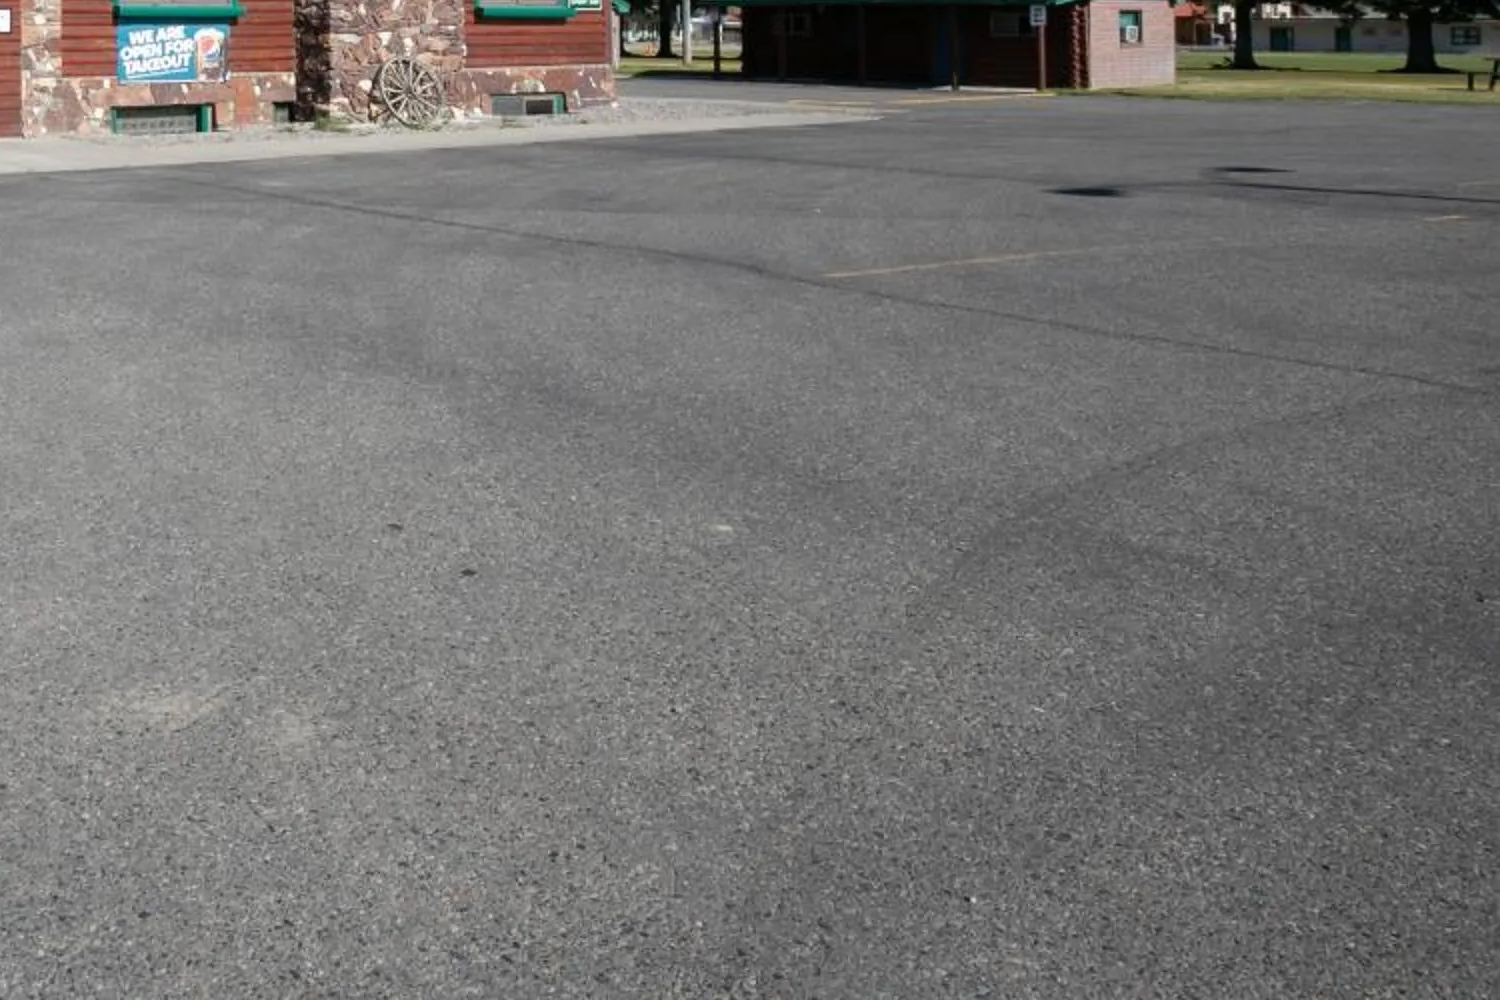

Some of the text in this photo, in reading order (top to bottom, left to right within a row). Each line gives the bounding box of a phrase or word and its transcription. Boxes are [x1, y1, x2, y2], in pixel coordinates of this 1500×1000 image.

[128, 24, 186, 46] WE ARE
[120, 38, 196, 61] OPEN FOR
[123, 53, 193, 76] TAKEOUT
